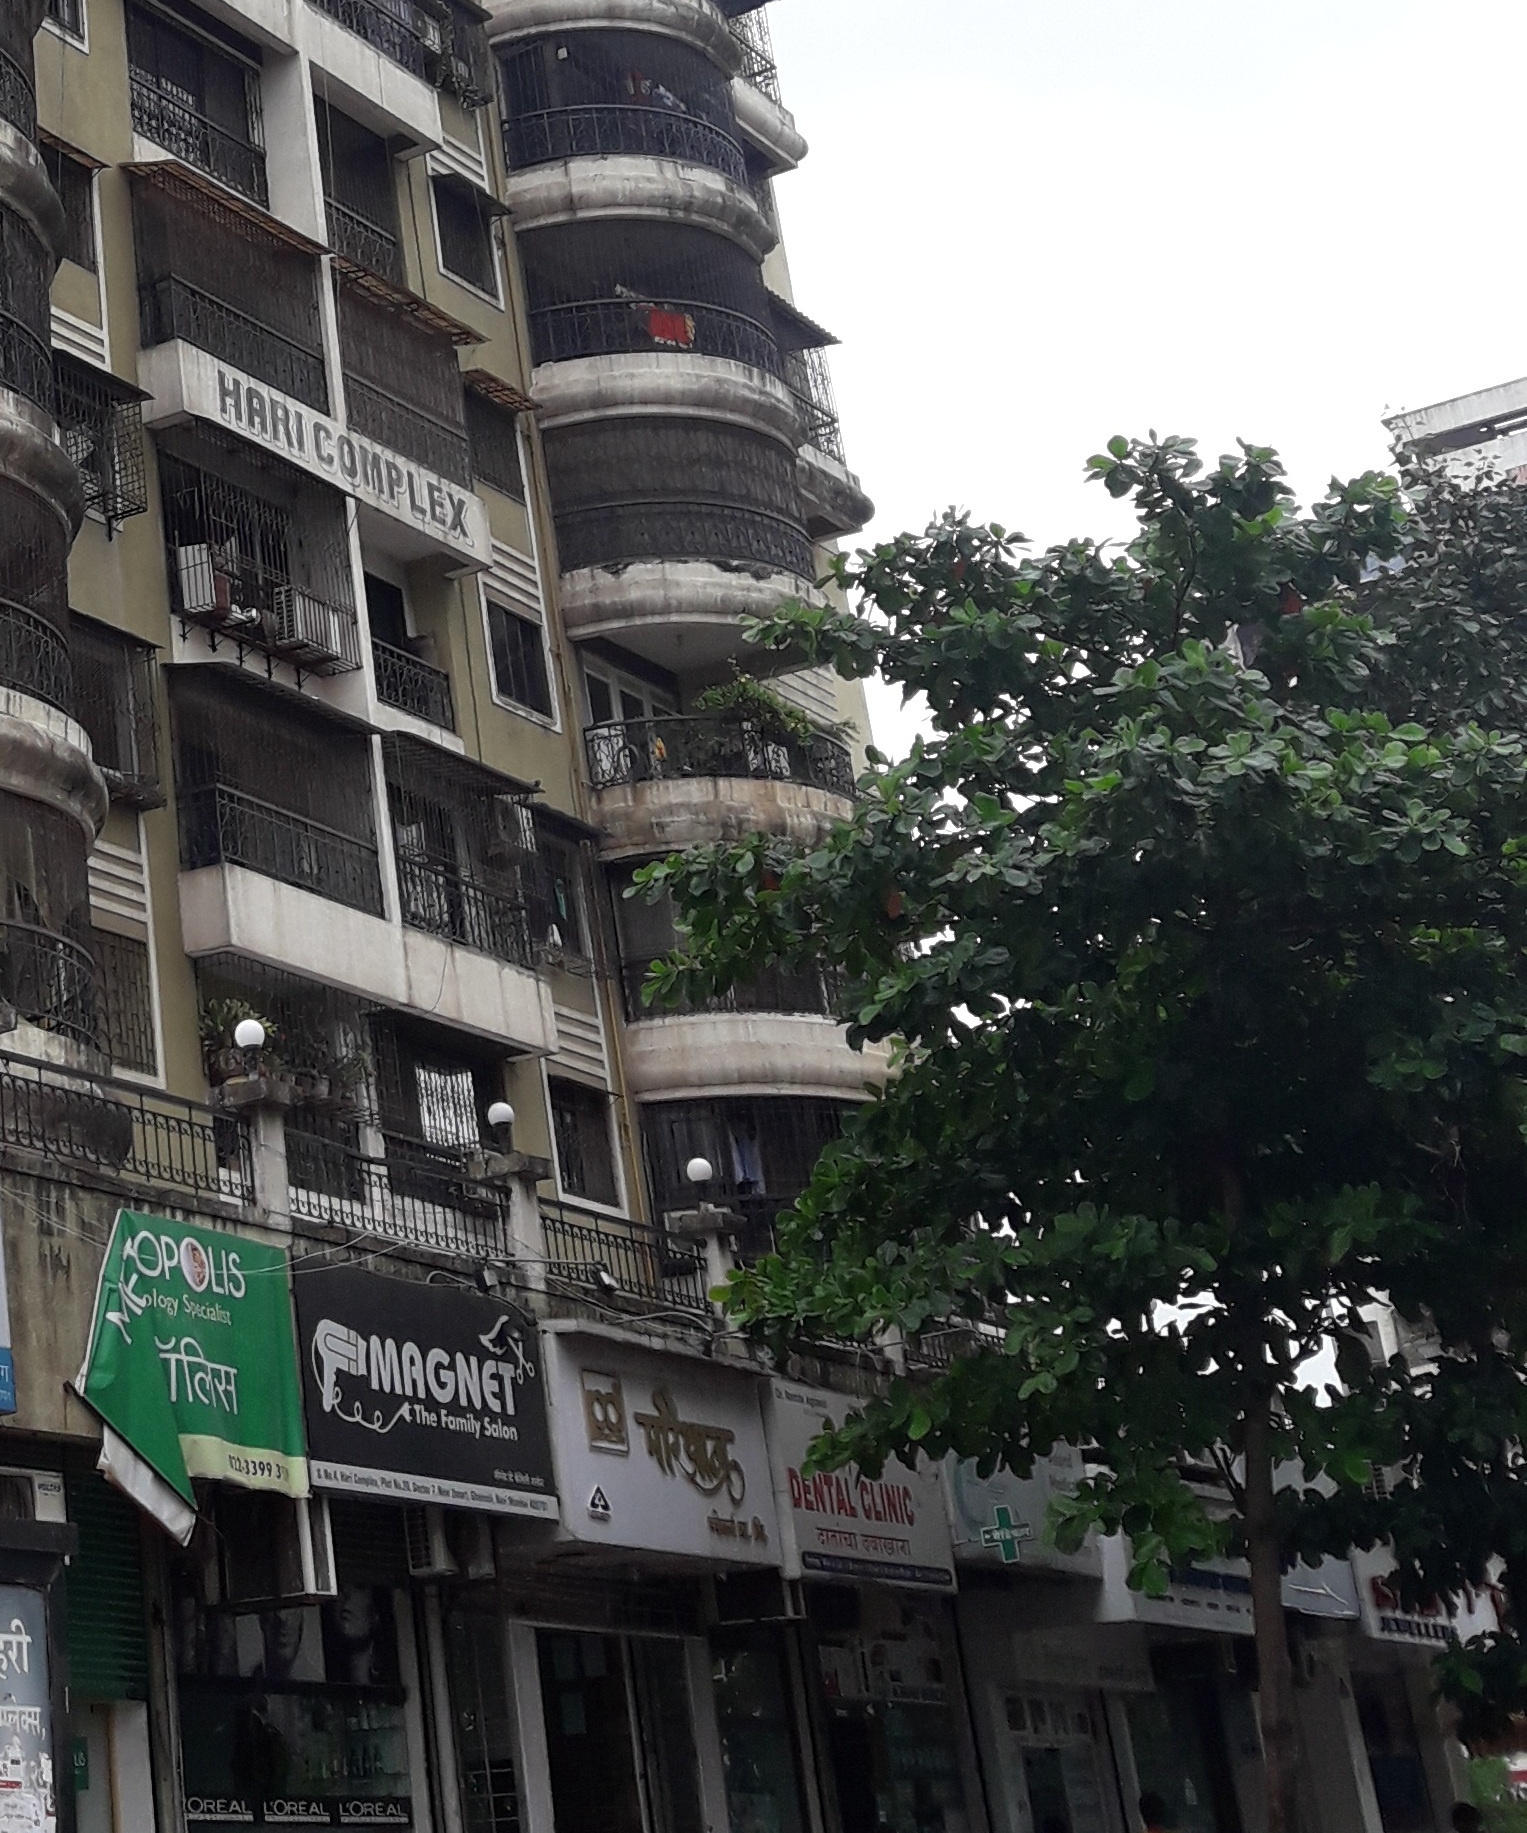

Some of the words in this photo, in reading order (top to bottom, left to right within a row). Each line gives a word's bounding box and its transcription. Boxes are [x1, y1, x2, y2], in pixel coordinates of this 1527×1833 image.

[217, 368, 308, 458] HARI
[312, 421, 473, 544] COMPLEX
[183, 1294, 232, 1326] Specialist
[370, 1334, 516, 1416] MAGNET
[413, 1404, 438, 1427] The
[440, 1408, 481, 1440] Family
[484, 1416, 519, 1441] Salon
[787, 1467, 858, 1519] DENTAL
[860, 1479, 915, 1527] CLINIC
